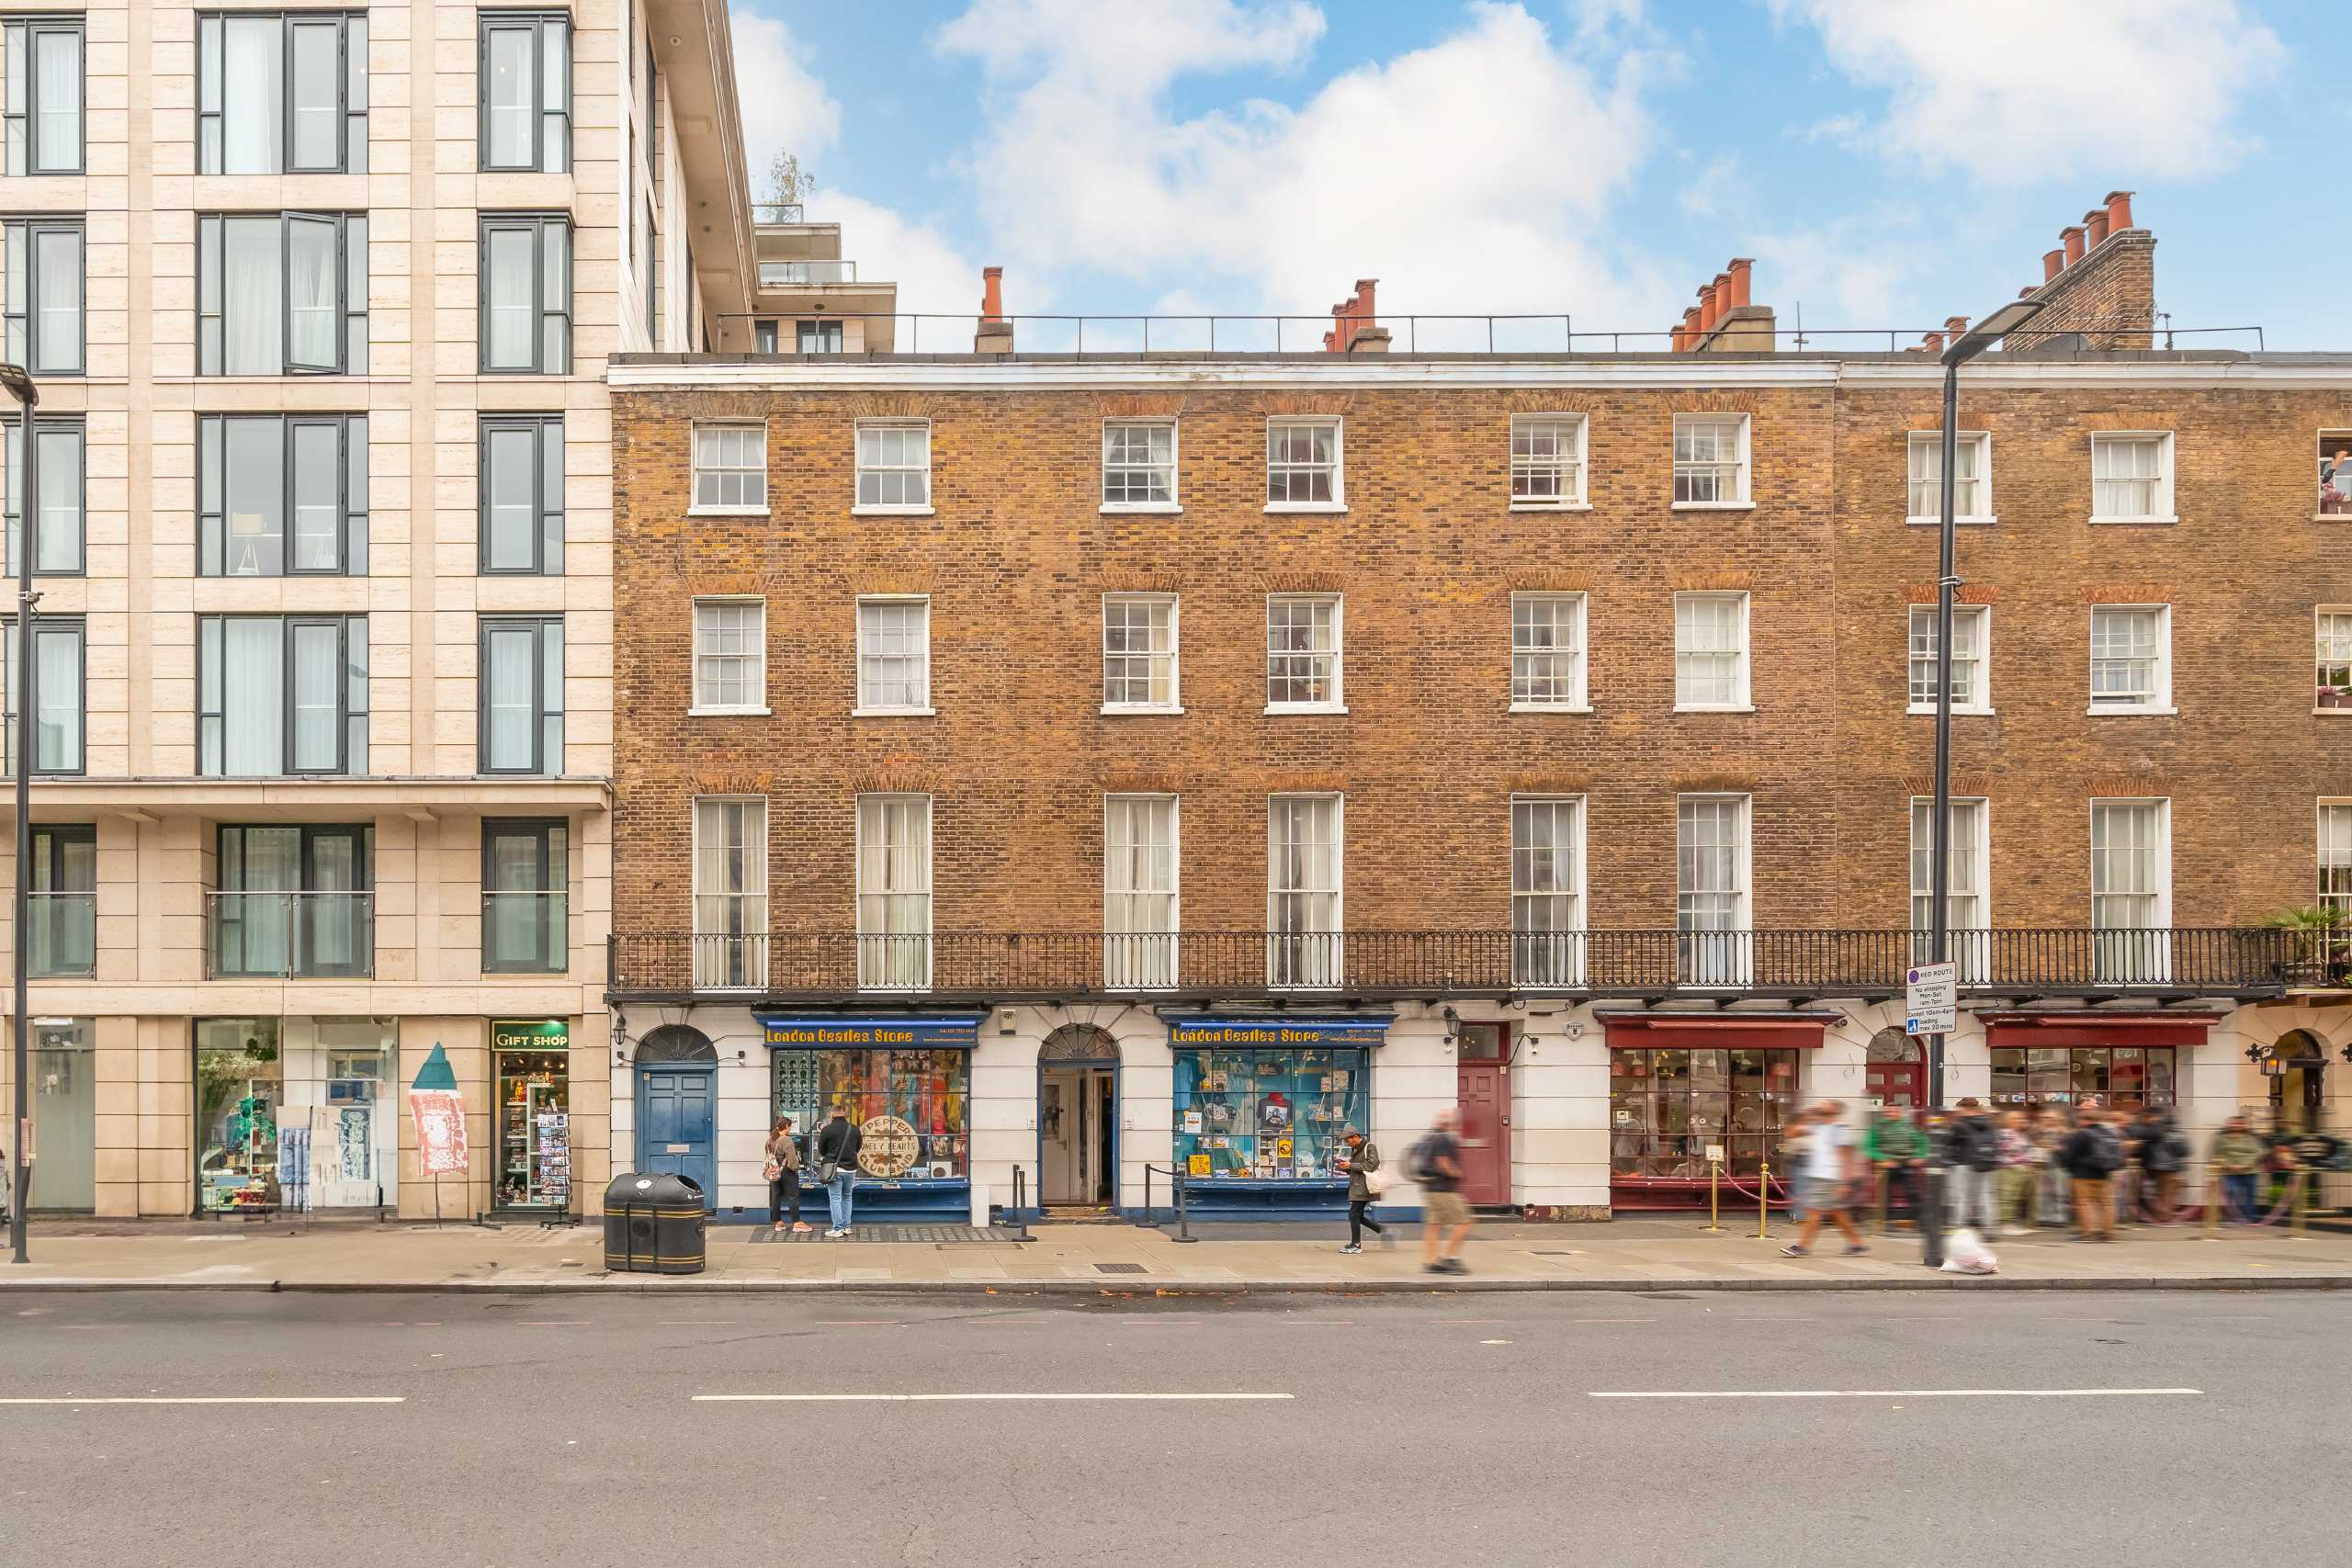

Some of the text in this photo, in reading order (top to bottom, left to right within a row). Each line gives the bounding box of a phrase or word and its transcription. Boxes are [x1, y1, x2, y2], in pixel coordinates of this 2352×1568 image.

[1933, 968, 1953, 976] ROUTE
[496, 1033, 568, 1046] GIFT SHOP
[765, 1028, 913, 1043] London Beatles Store
[1171, 1028, 1320, 1043] London Beatles Store
